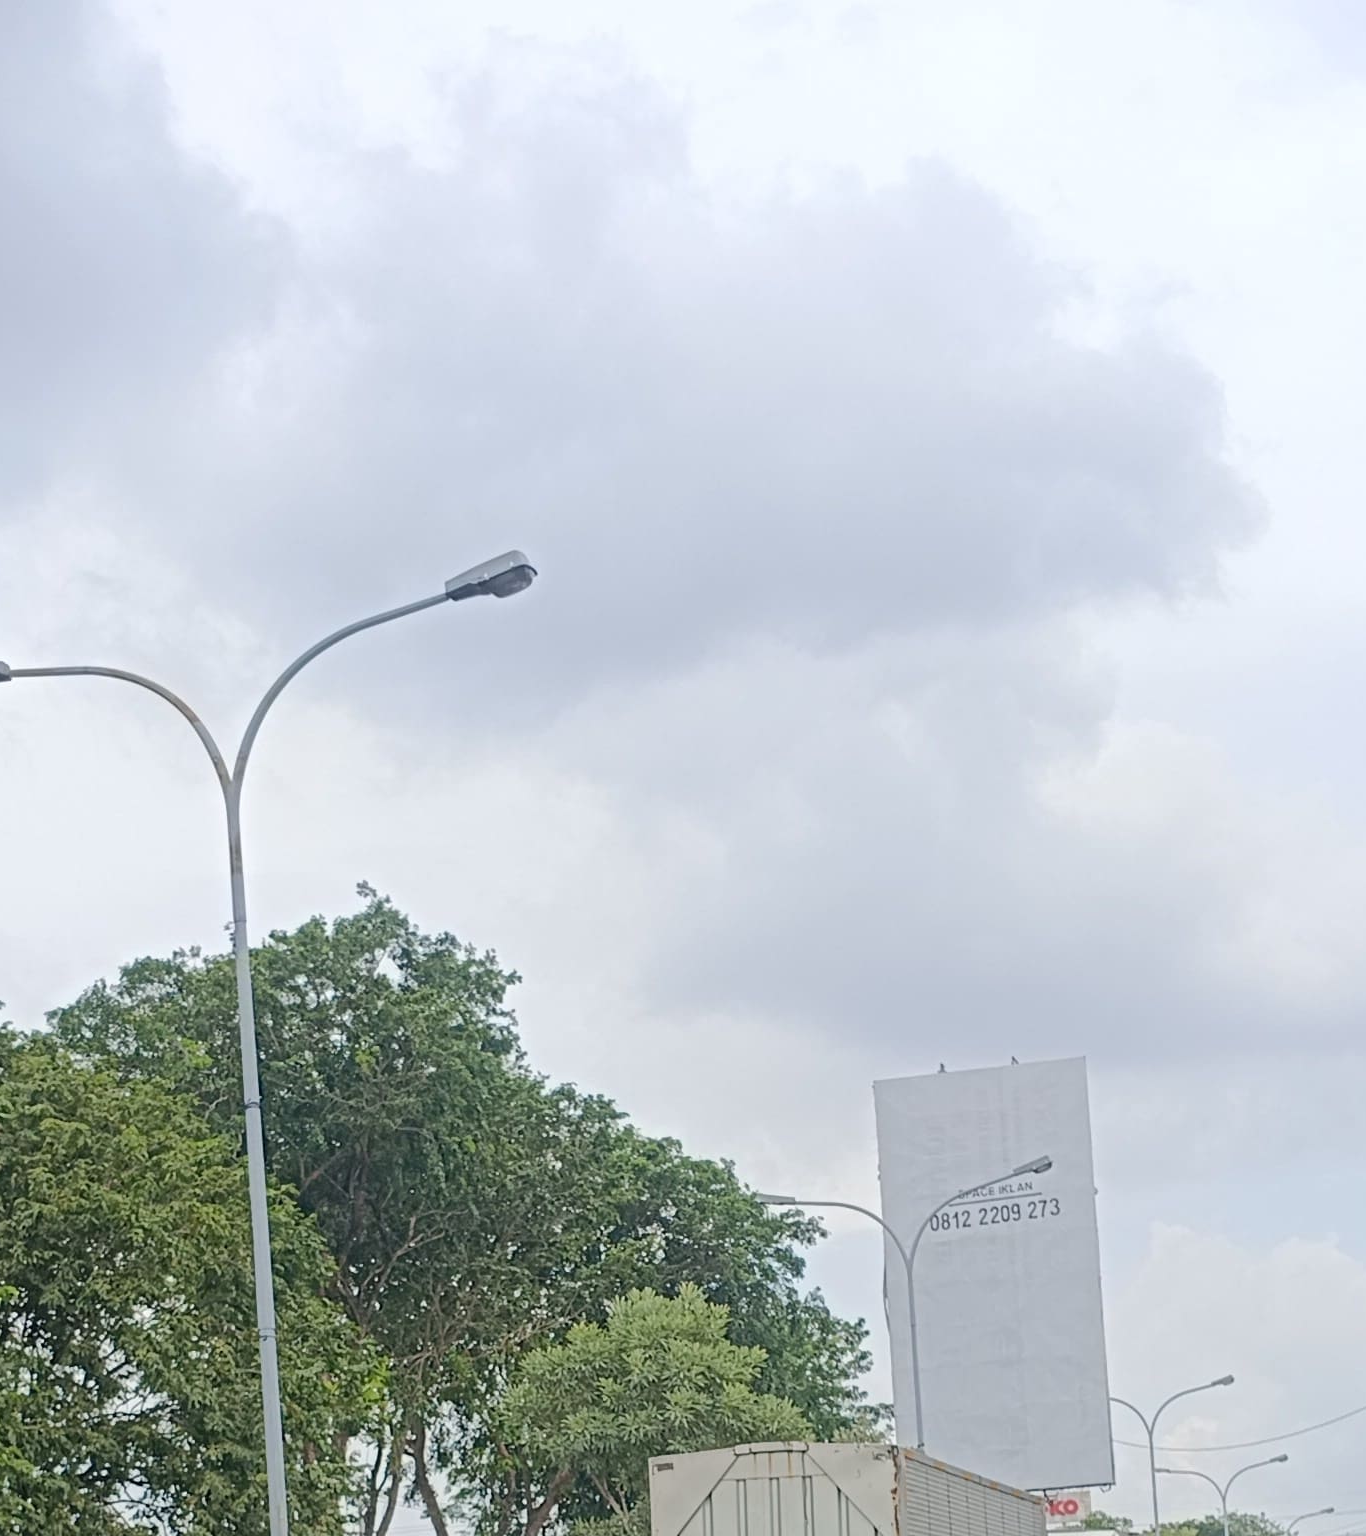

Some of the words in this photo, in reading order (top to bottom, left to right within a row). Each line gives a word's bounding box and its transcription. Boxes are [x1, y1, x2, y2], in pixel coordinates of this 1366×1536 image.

[958, 1186, 995, 1200] SPACE
[998, 1181, 1033, 1195] IKLAN
[930, 1210, 971, 1231] 0812
[978, 1203, 1021, 1226] 2209
[1027, 1198, 1060, 1219] 273
